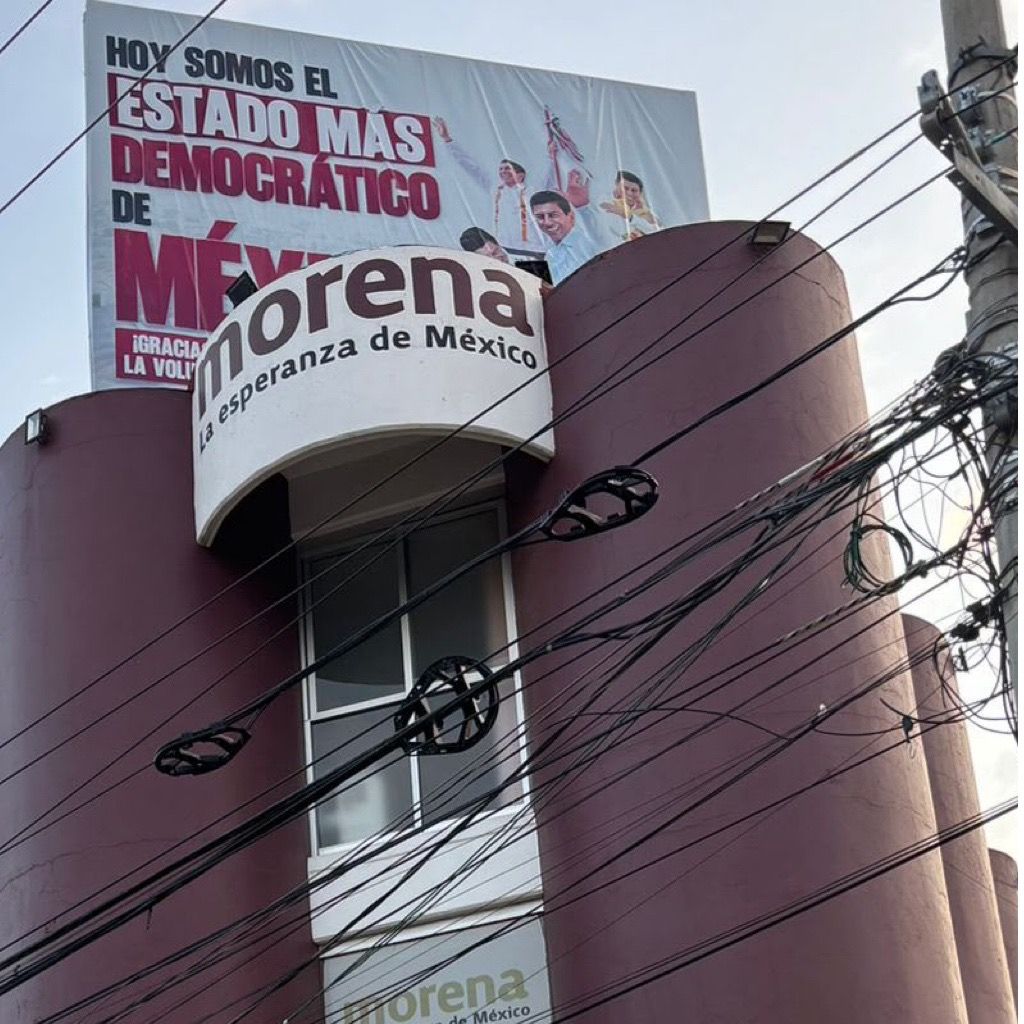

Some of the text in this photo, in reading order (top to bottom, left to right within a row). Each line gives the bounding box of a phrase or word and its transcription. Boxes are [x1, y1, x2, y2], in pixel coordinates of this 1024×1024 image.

[106, 36, 338, 99] HOY SOMOS EL
[116, 77, 300, 149] ESTADO
[110, 133, 441, 221] DEMOCRÁTICO
[112, 189, 152, 226] DE
[124, 355, 146, 375] LA
[133, 335, 205, 359] ¡GRACIA
[198, 256, 535, 420] morena
[199, 325, 537, 454] La esperanza de México
